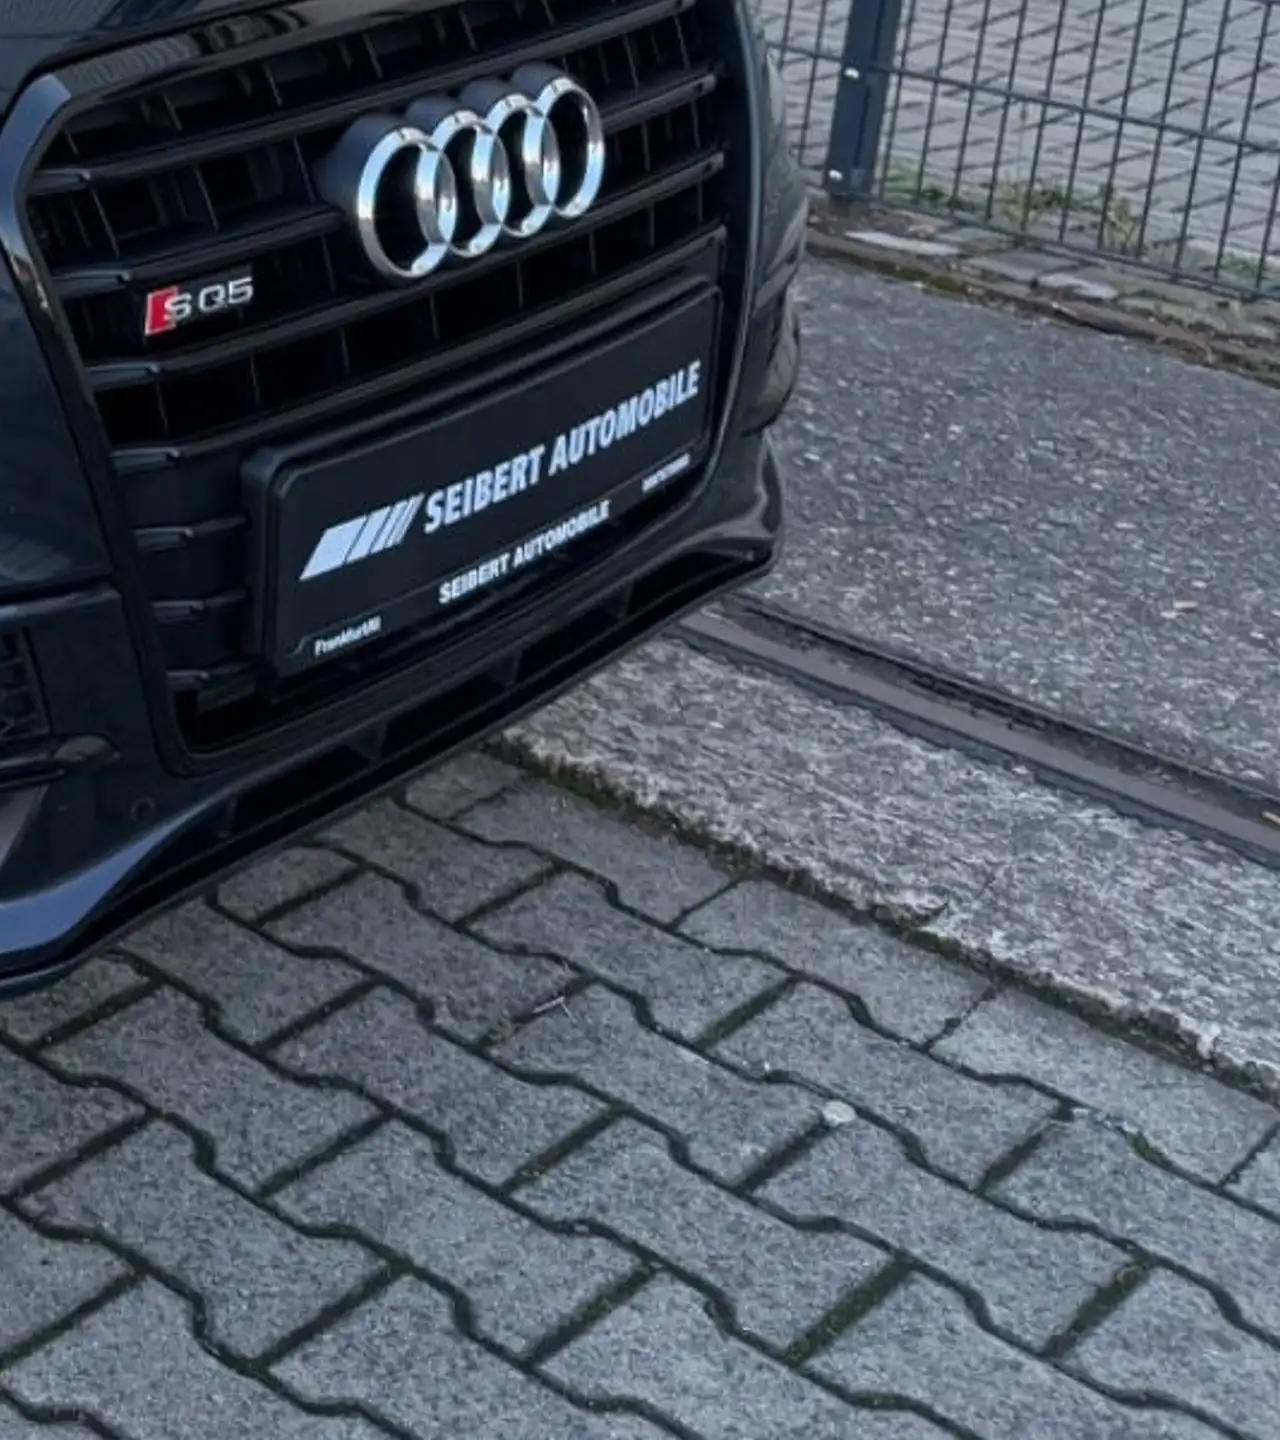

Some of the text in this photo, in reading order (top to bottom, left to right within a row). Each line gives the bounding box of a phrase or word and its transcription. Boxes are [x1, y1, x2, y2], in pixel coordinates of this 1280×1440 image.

[424, 359, 701, 534] SEIBERT AUTOMOBILE
[438, 499, 611, 604] SEIBERT AUTOMOBILE
